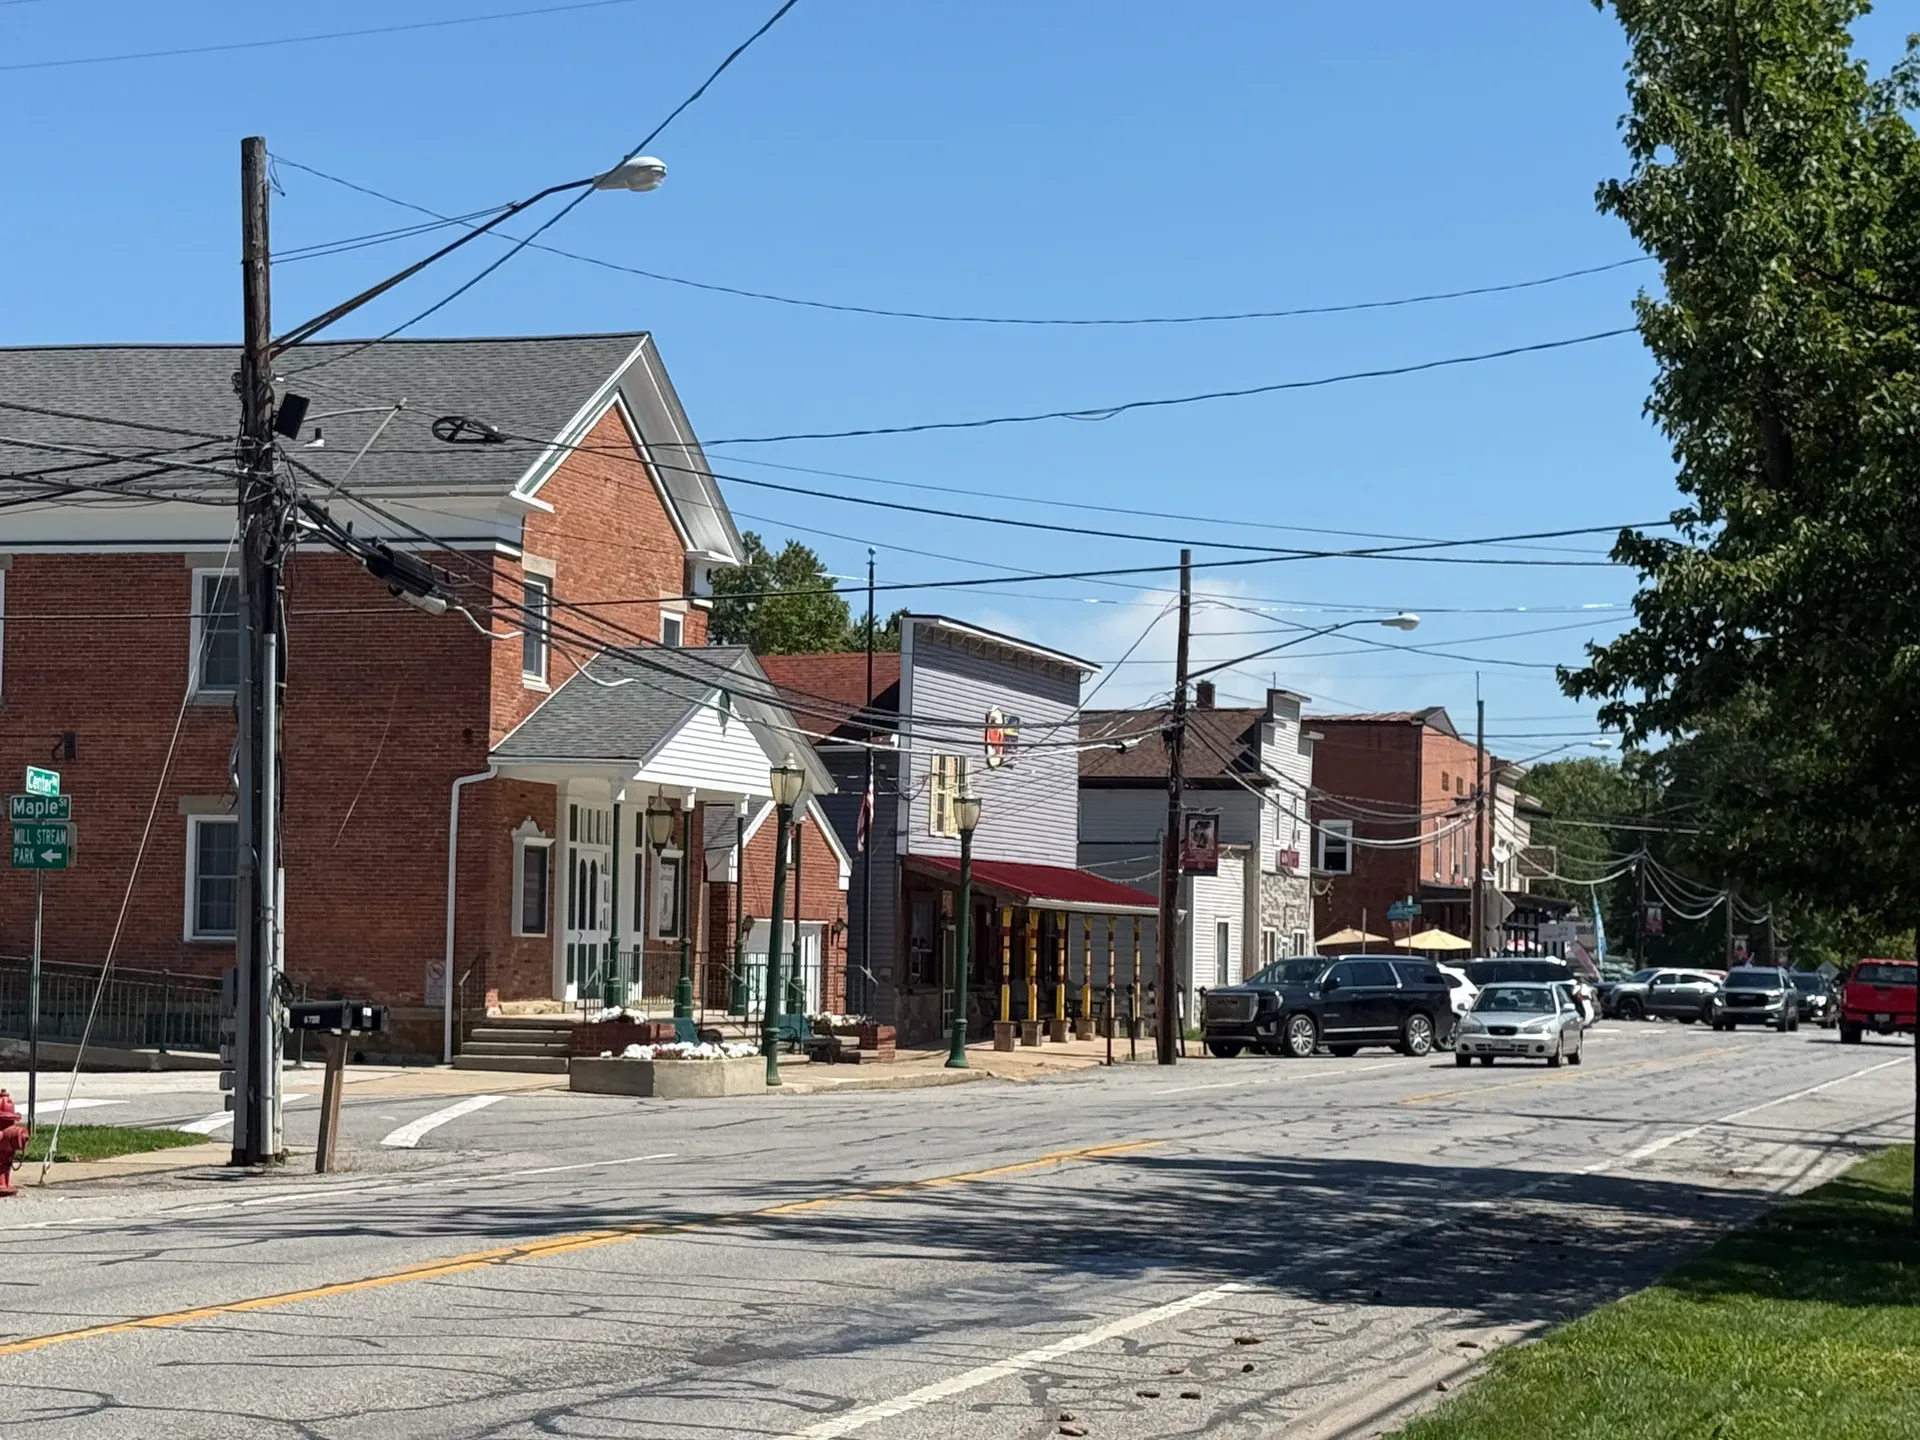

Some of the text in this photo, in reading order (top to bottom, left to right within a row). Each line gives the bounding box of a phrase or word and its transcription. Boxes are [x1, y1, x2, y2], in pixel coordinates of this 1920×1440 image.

[28, 771, 52, 792] Center
[13, 798, 67, 818] Maple St
[14, 828, 67, 845] MILL STREAM
[13, 847, 35, 864] PARK
